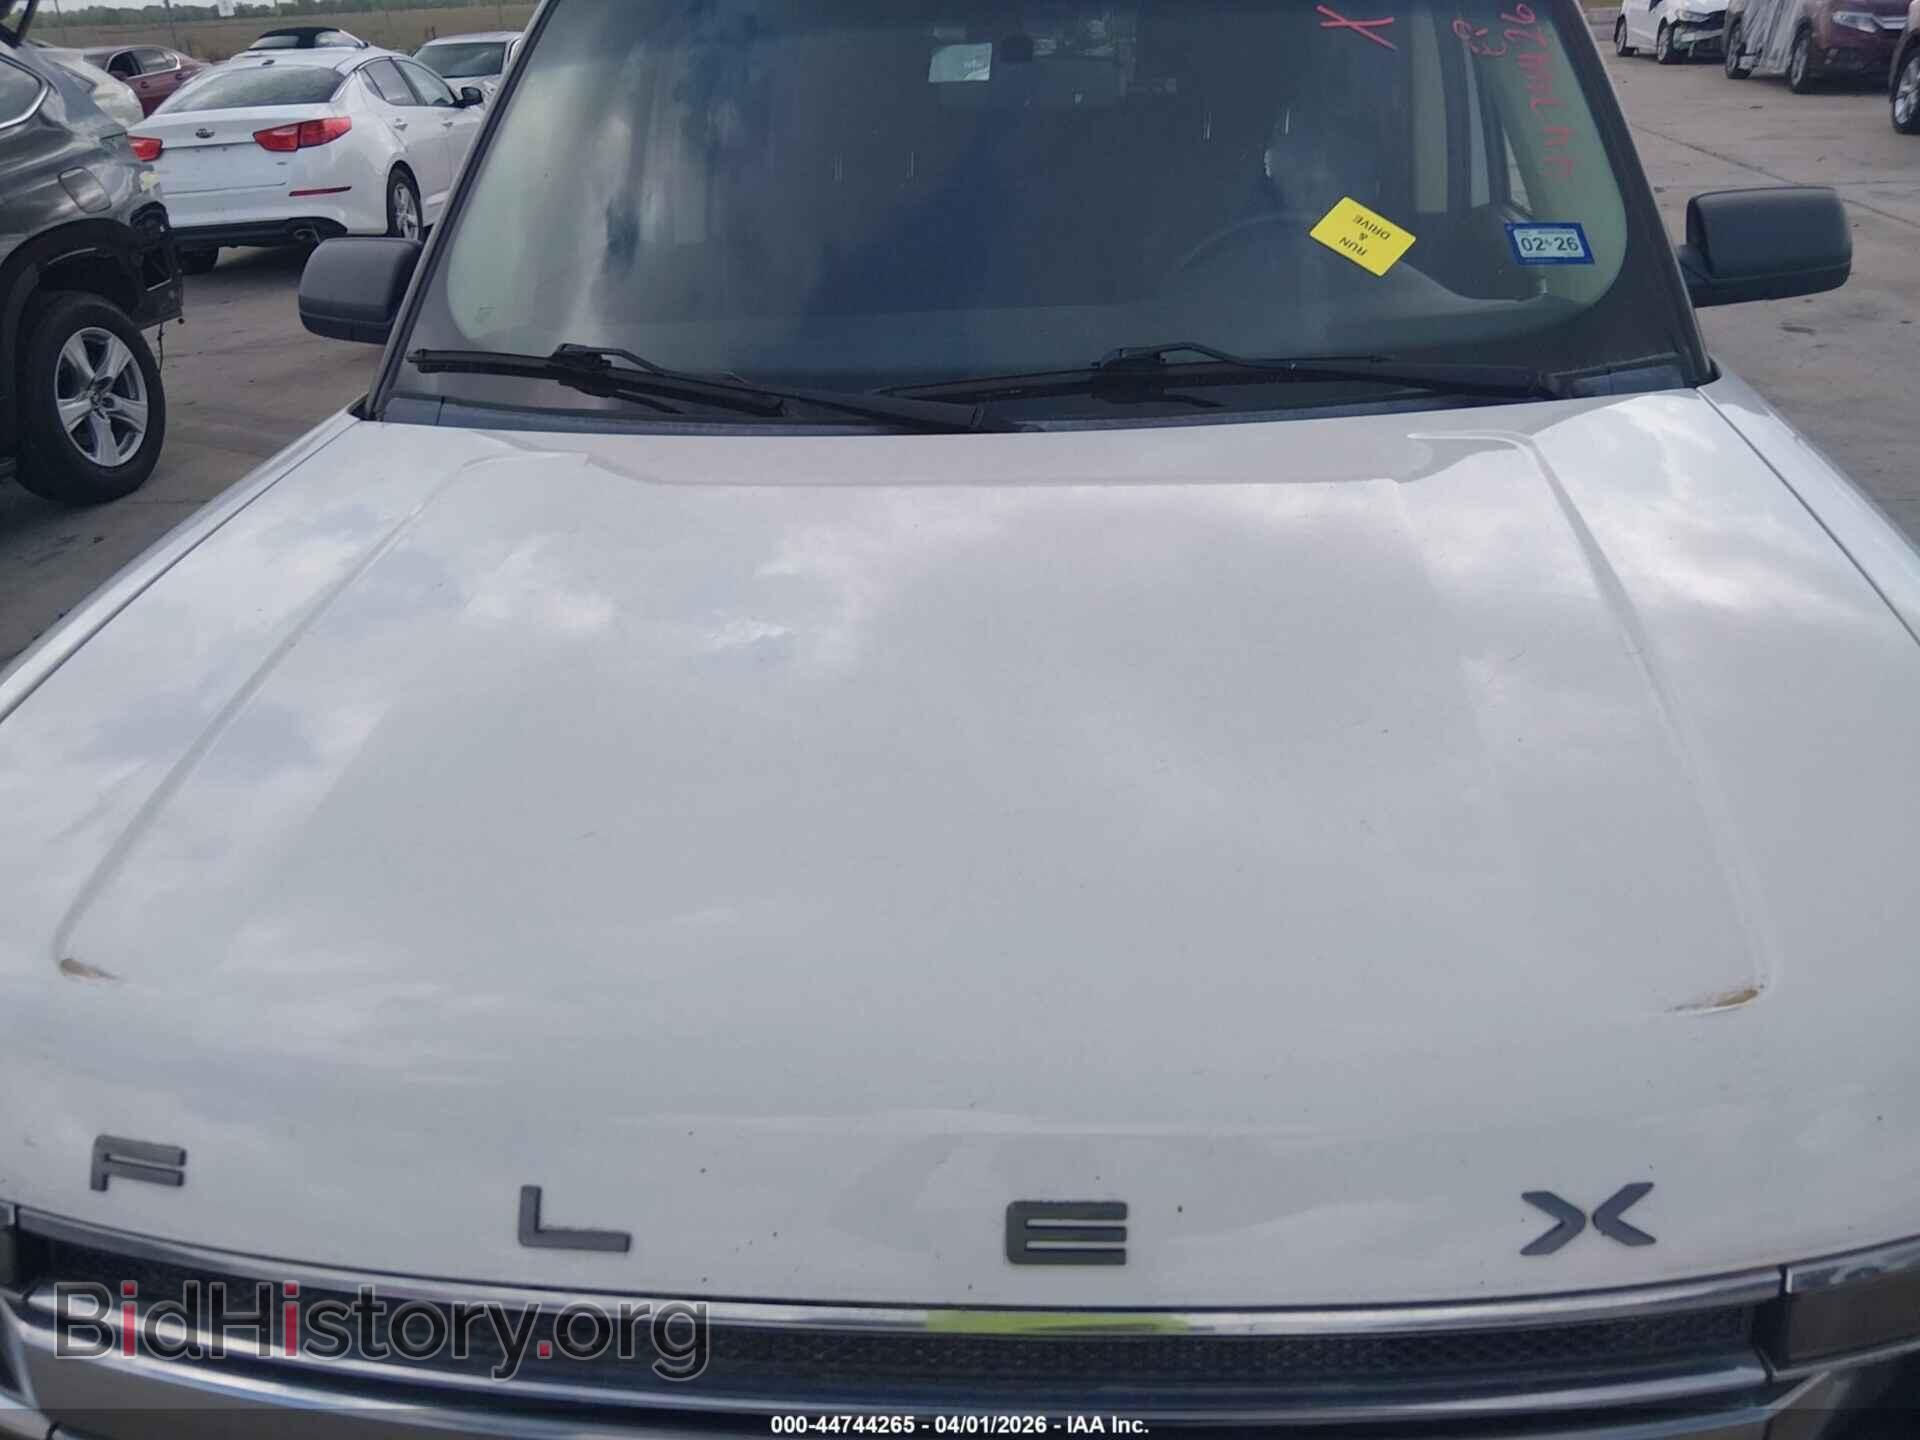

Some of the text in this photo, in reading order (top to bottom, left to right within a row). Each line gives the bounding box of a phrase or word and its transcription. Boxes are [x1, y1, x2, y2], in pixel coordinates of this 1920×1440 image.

[1352, 213, 1392, 241] DRIVE
[1338, 236, 1368, 257] RUN
[1520, 236, 1579, 252] 02 26
